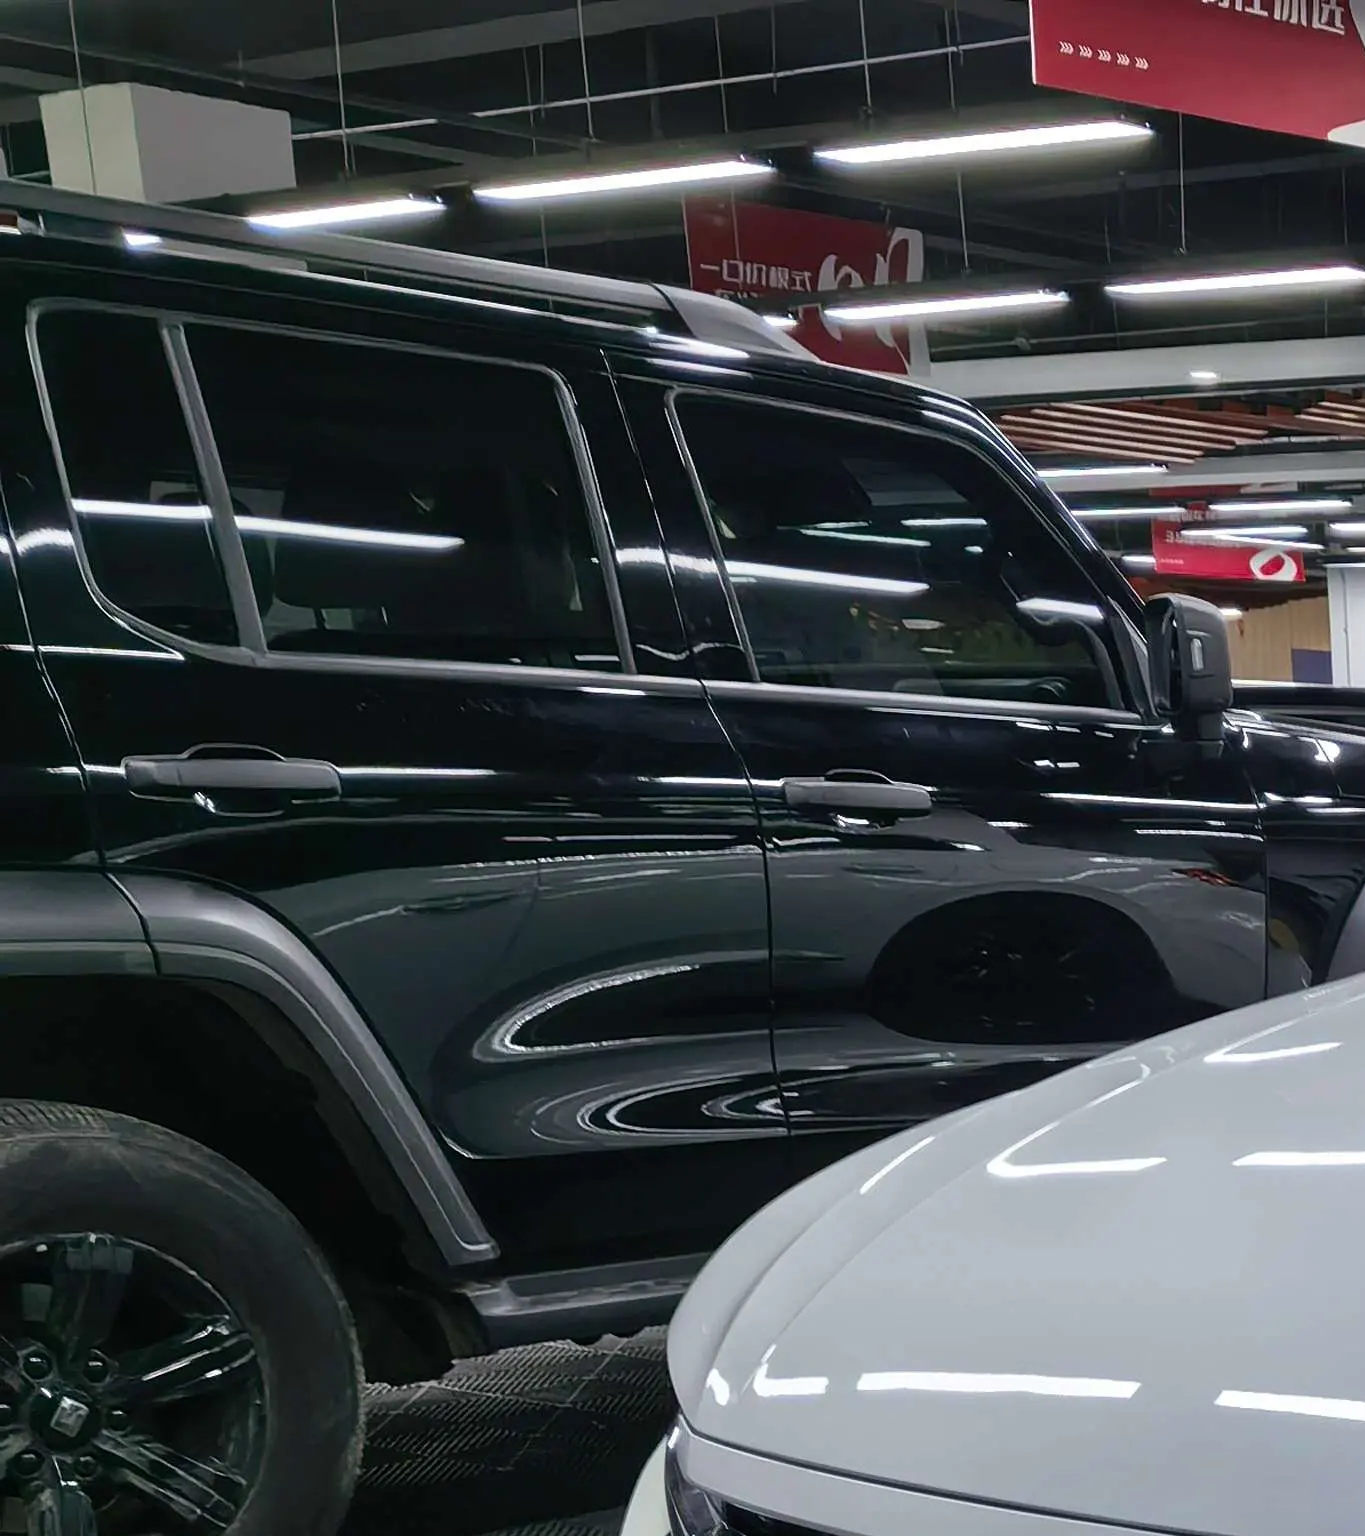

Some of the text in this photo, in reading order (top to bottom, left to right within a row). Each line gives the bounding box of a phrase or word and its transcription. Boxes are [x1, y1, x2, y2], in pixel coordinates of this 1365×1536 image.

[700, 258, 813, 293] 一口价模式
